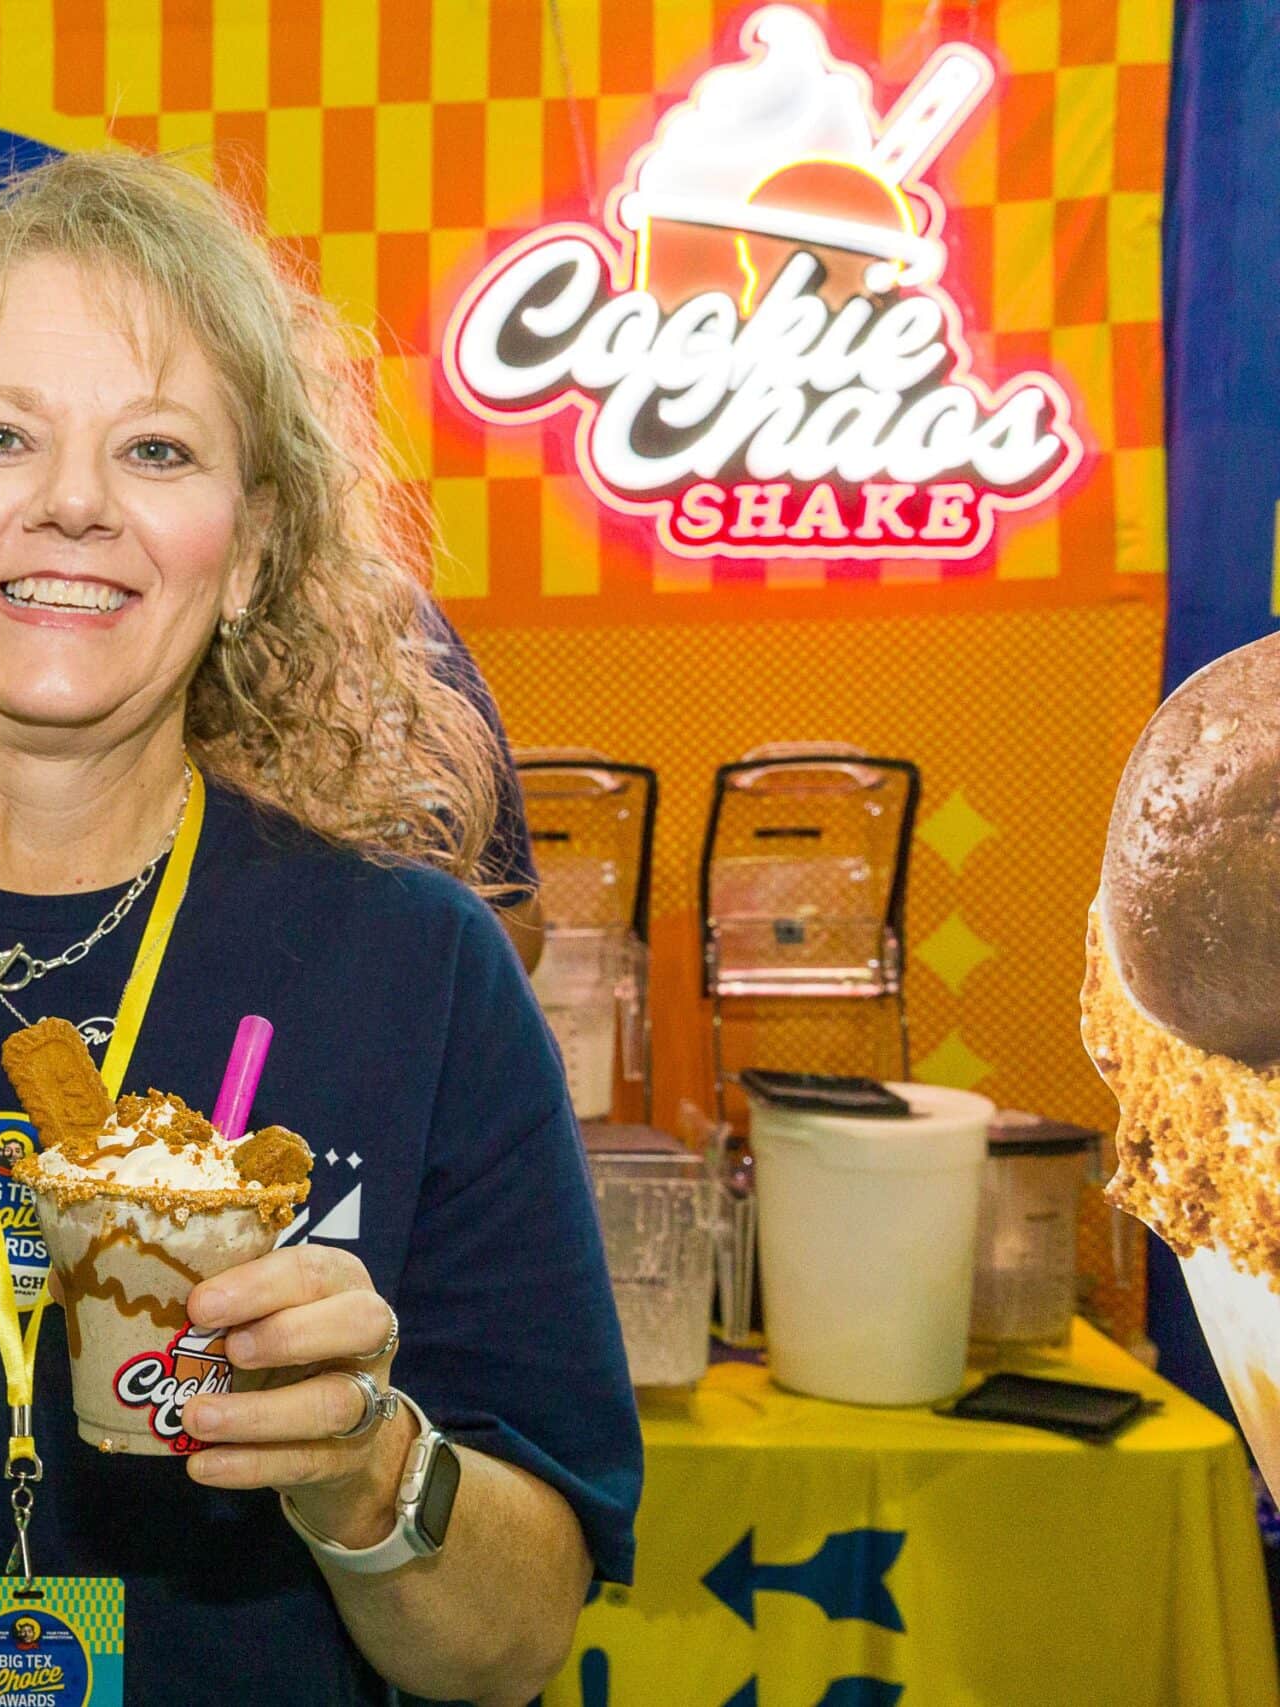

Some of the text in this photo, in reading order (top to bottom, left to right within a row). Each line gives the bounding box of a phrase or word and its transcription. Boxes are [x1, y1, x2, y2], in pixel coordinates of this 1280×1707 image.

[459, 239, 946, 402] Cookie
[592, 377, 1060, 490] Chaos
[677, 484, 976, 539] SHAKE
[7, 1182, 37, 1204] TE
[25, 1654, 53, 1668] TEX
